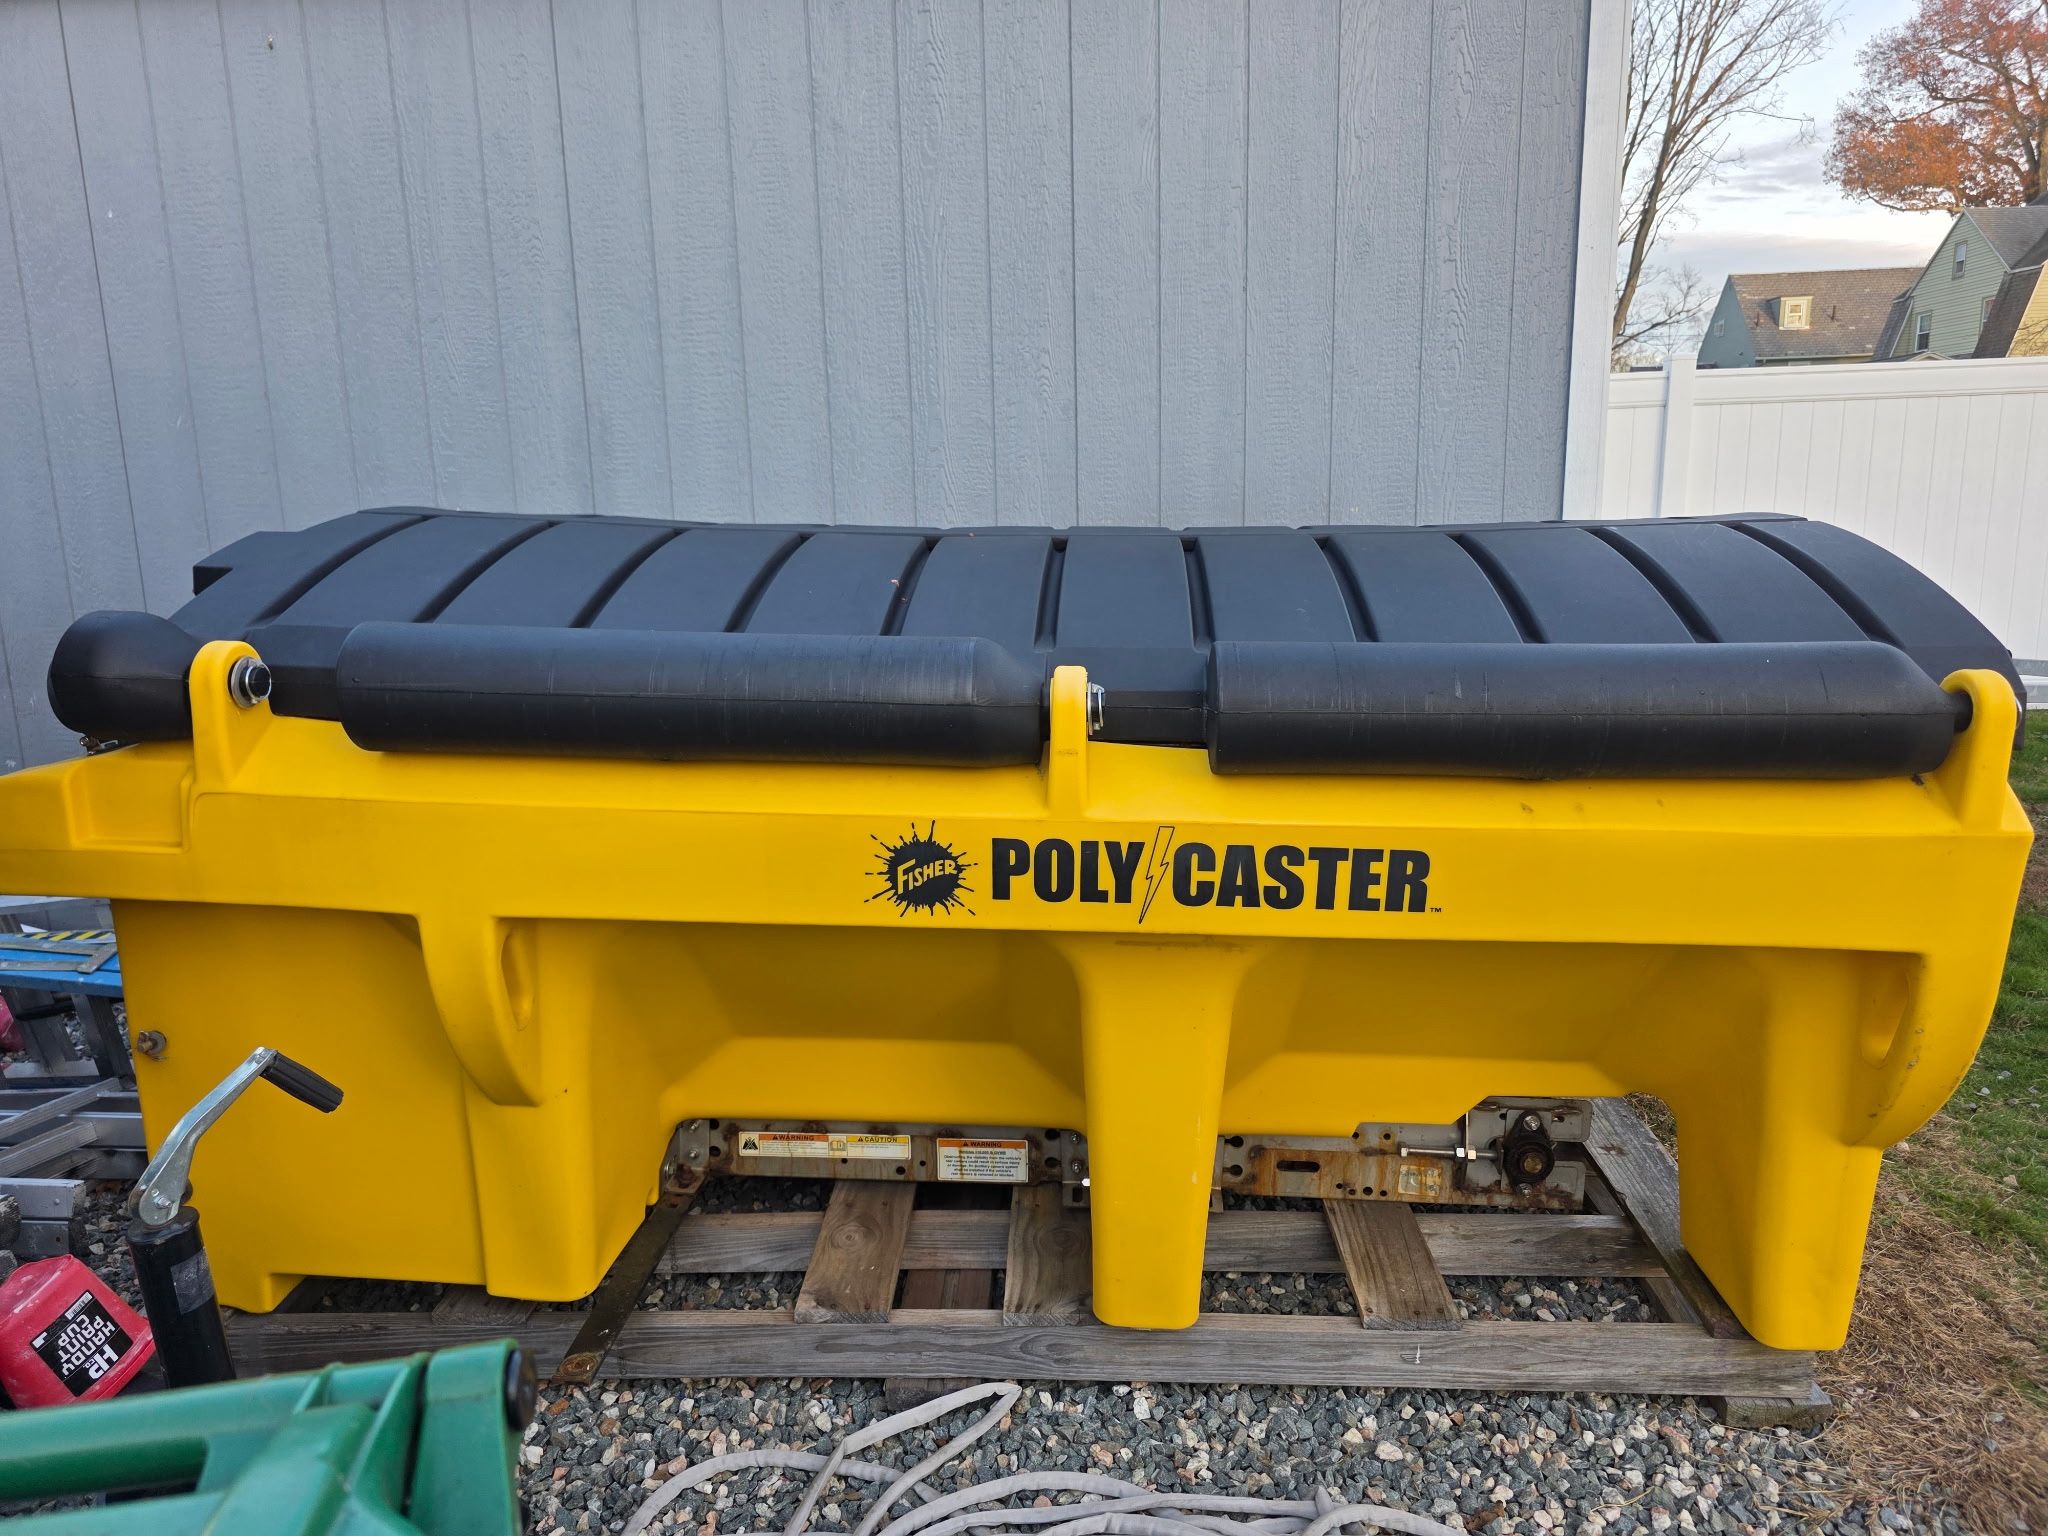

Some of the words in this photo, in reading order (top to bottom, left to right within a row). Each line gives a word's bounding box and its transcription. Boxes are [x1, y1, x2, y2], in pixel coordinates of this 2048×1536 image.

[897, 858, 958, 895] FISHER
[991, 838, 1144, 904] POLY
[1173, 844, 1431, 913] CASTER
[57, 1314, 90, 1346] CUP
[57, 1315, 104, 1363] PAINT
[62, 1321, 115, 1376] HANDY
[88, 1343, 119, 1379] HP
